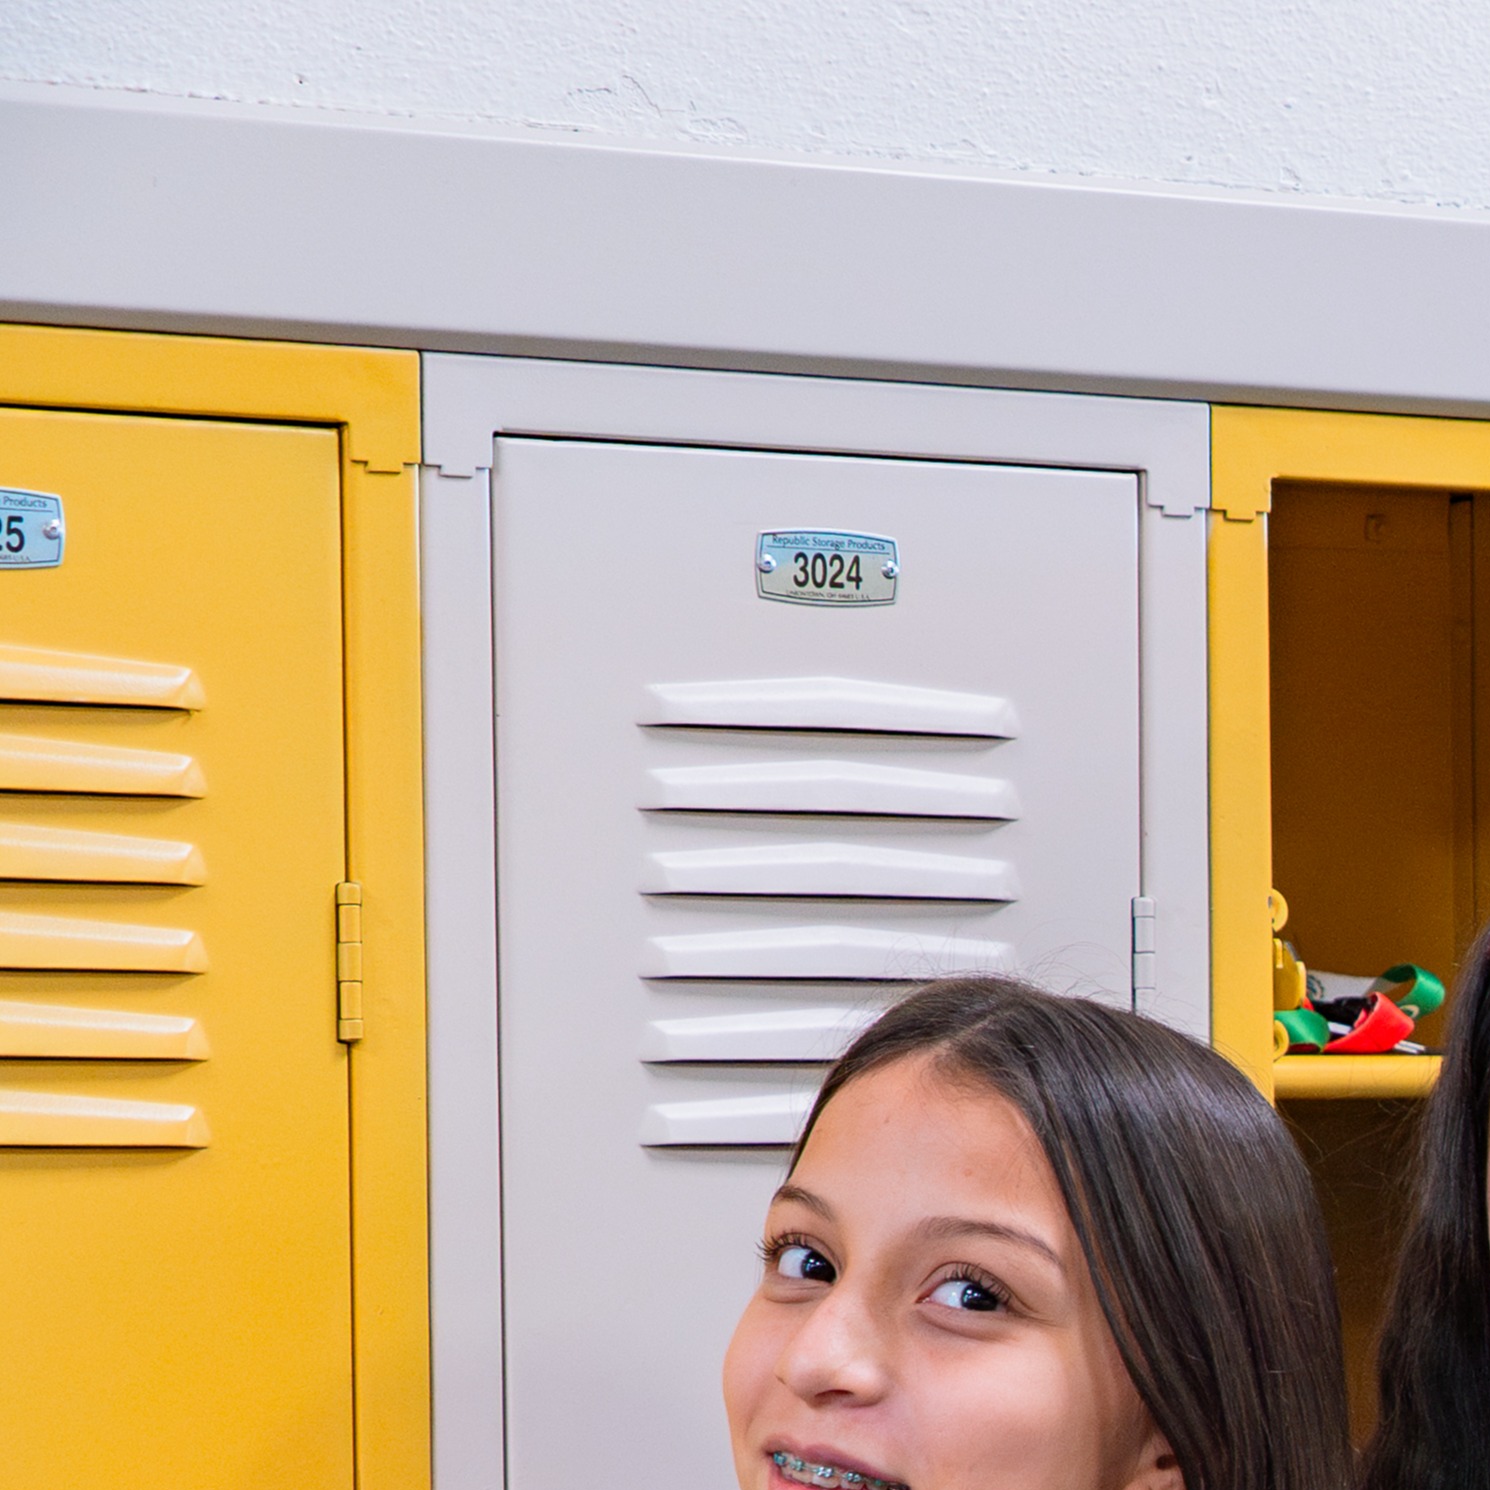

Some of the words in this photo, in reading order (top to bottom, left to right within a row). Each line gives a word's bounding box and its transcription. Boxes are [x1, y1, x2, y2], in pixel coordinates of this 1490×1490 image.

[3, 496, 48, 508] Products
[0, 515, 25, 553] 5
[771, 534, 810, 548] Republic
[812, 536, 846, 550] Storage
[847, 538, 886, 551] Products
[793, 551, 863, 590] 3024
